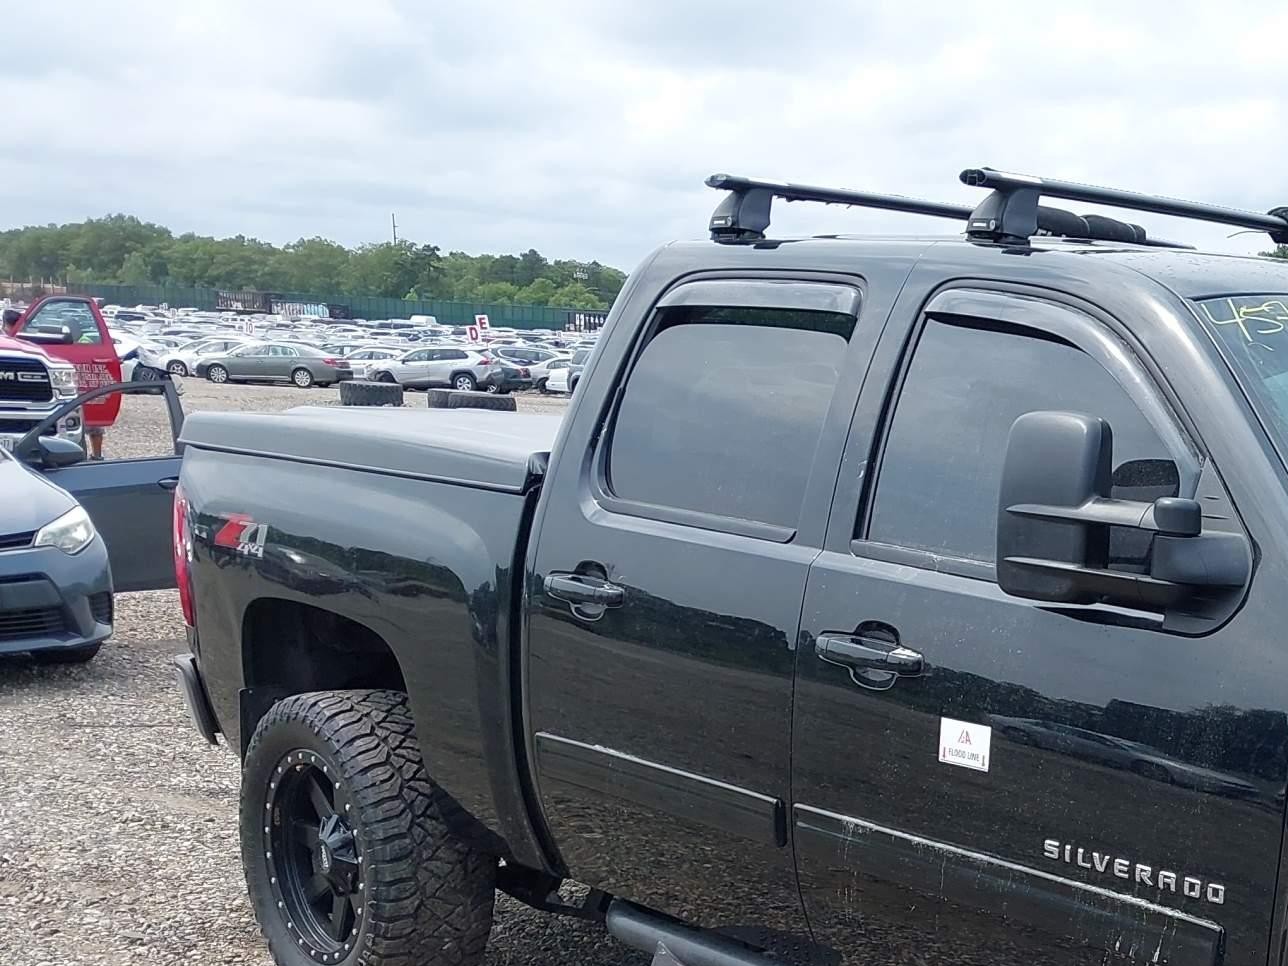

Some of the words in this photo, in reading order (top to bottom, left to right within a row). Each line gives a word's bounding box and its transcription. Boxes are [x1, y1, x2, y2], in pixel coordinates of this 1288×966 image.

[478, 317, 487, 330] E
[469, 326, 479, 341] D
[948, 747, 967, 759] FLOOD
[967, 751, 980, 762] LINE
[1043, 839, 1225, 905] SILVERADO
